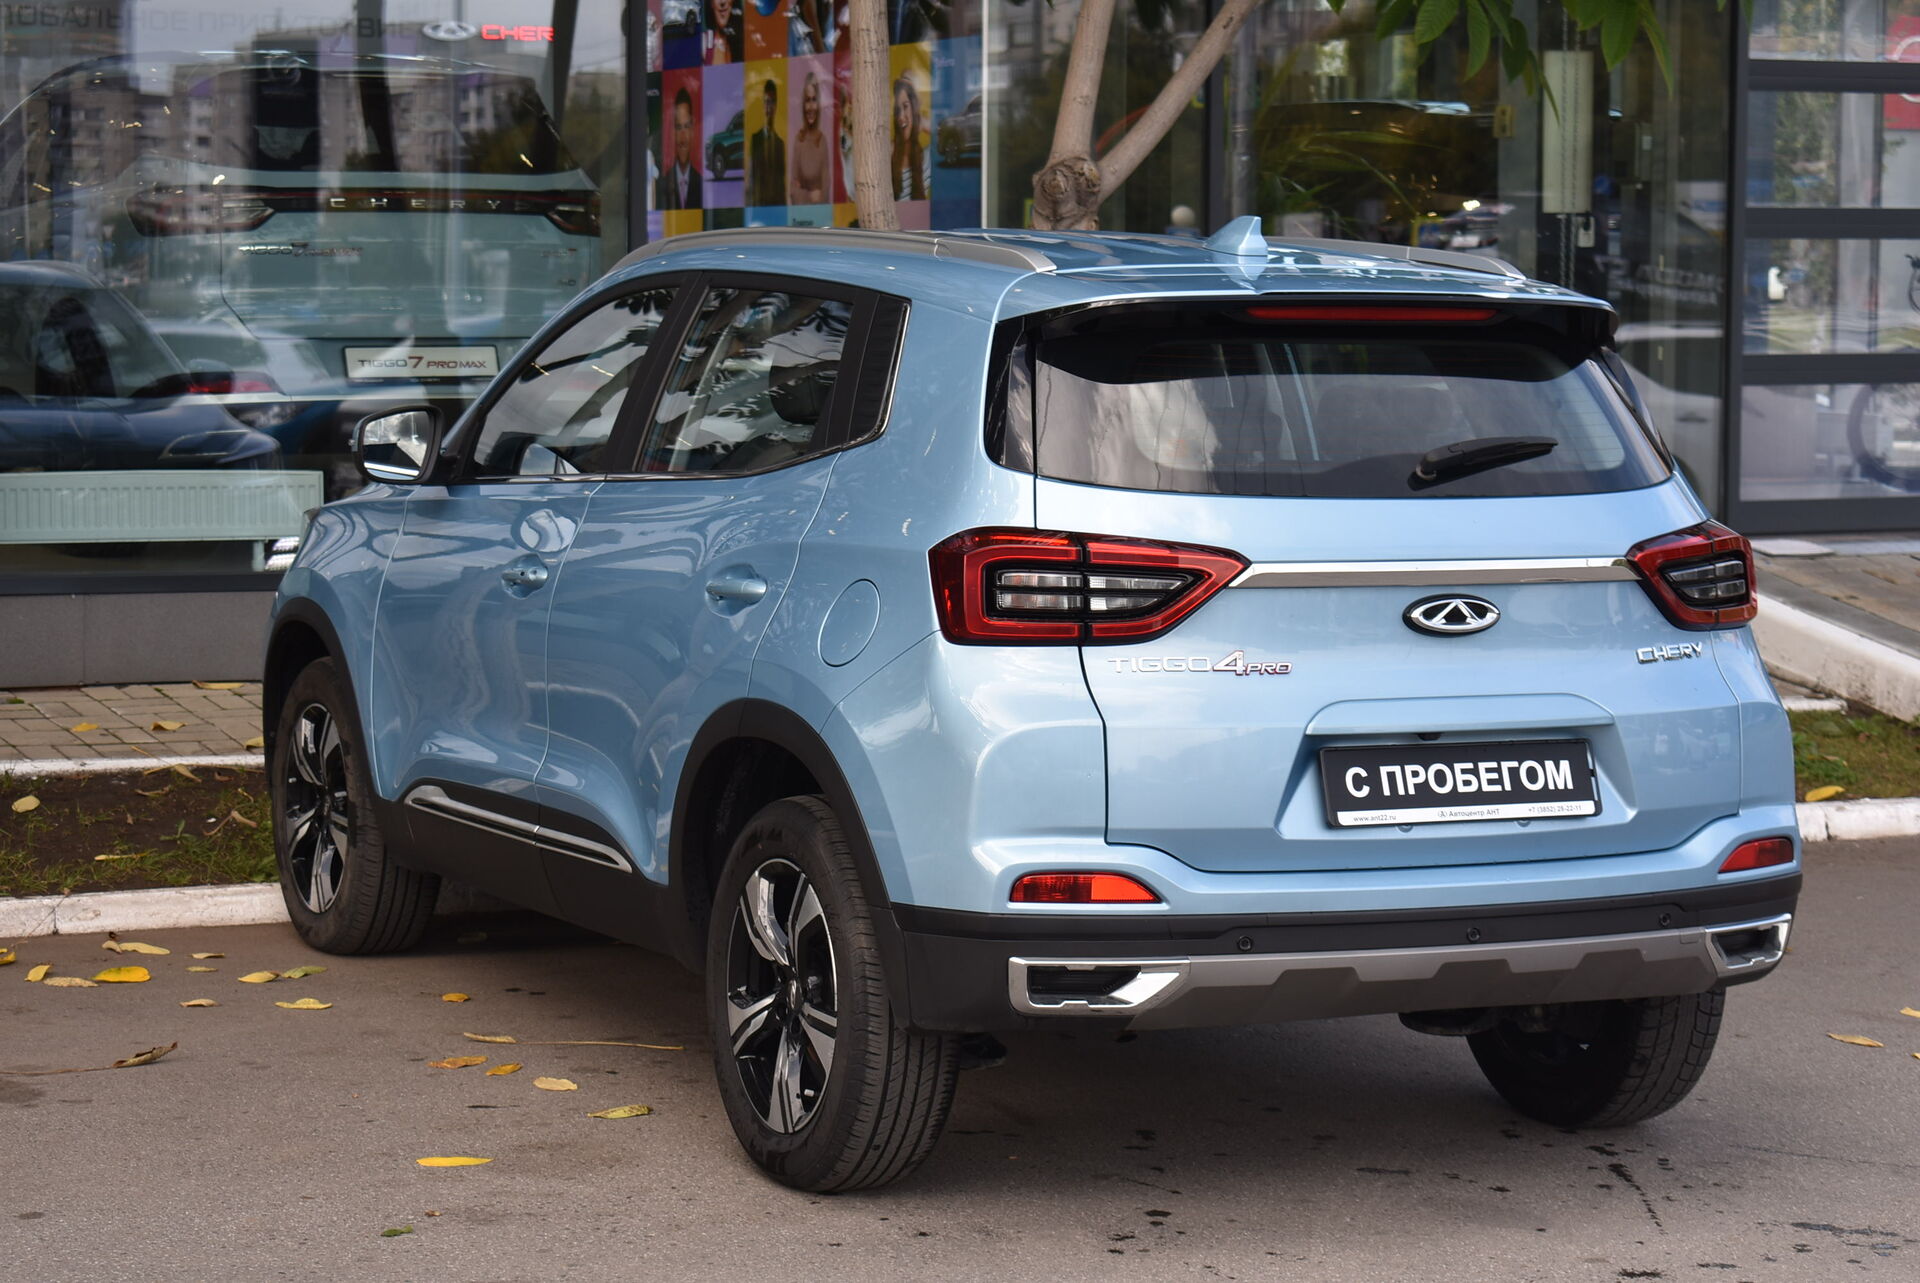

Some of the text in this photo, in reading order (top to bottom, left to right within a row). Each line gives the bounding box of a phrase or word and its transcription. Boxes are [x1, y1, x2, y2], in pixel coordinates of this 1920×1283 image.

[481, 24, 554, 42] CHER
[1636, 642, 1703, 664] CHERY
[1345, 759, 1574, 798] С ПРОБЕГОМ
